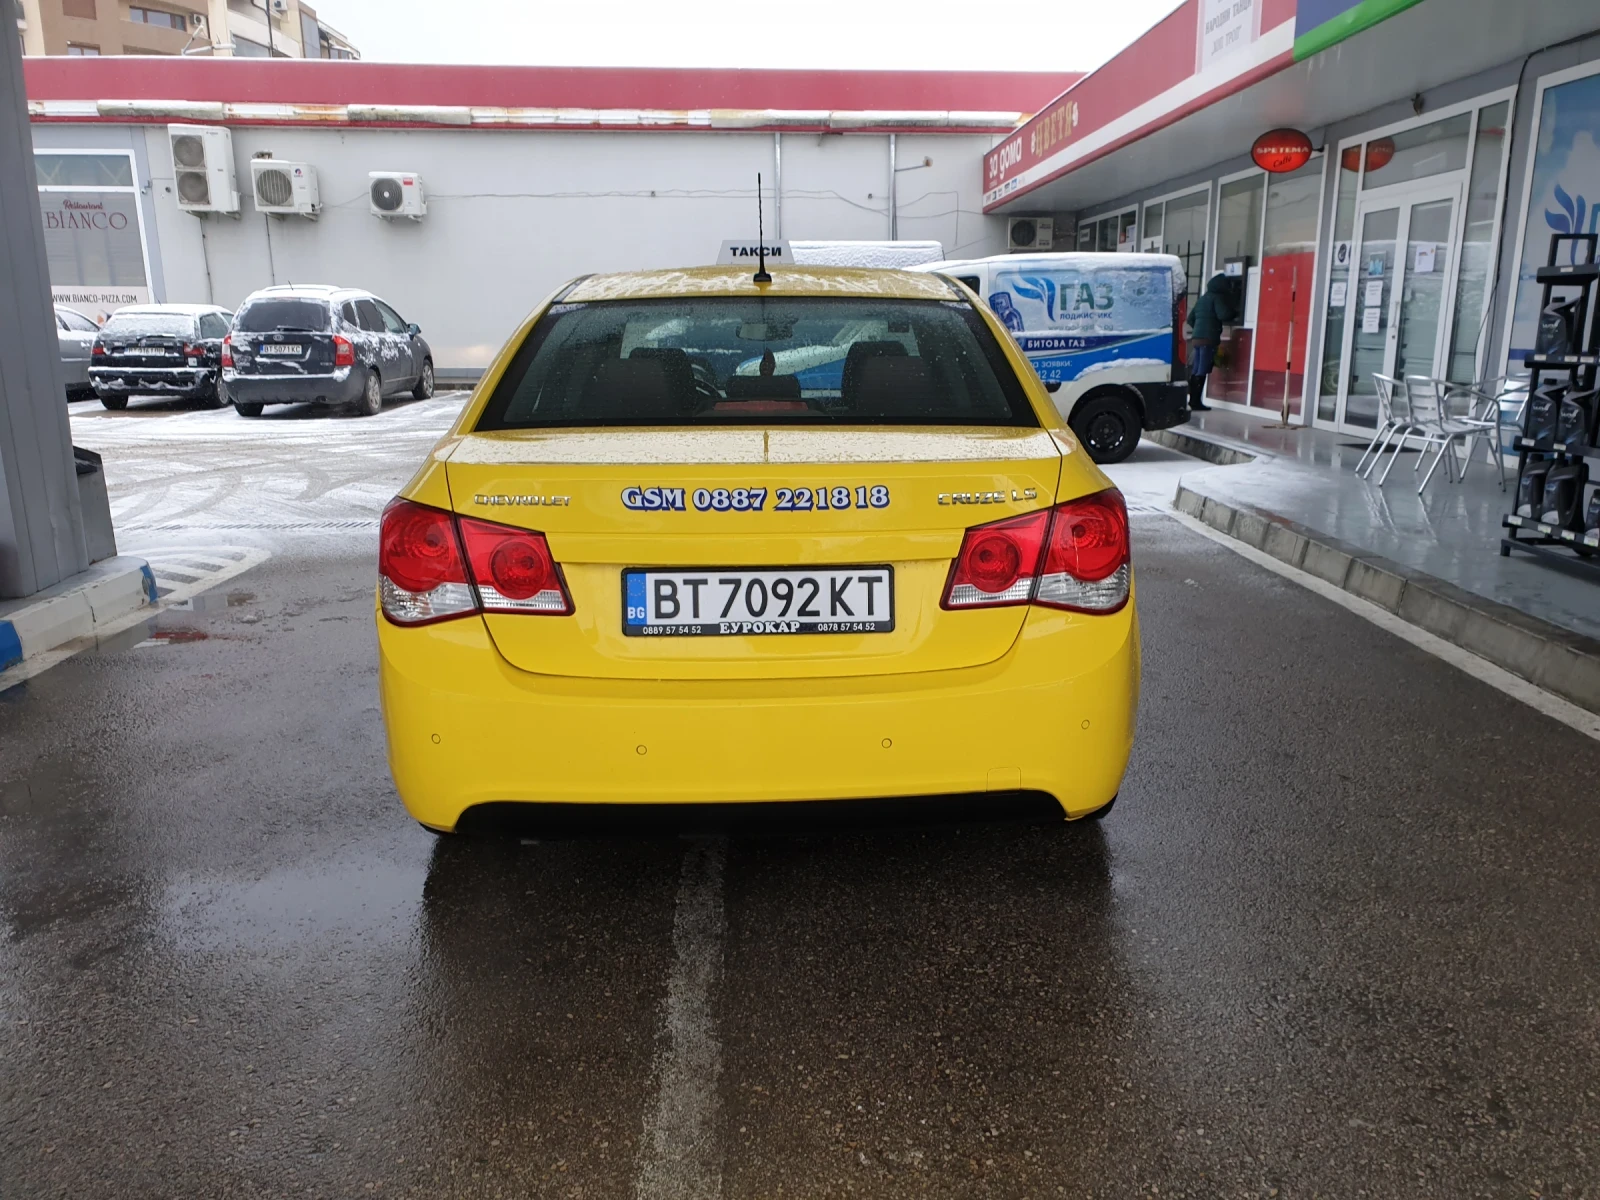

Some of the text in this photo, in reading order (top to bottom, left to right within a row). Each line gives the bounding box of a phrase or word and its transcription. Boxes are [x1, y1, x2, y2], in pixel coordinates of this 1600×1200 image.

[1036, 100, 1073, 158] ЦВЕТЯ
[63, 199, 103, 210] Restaurant
[45, 211, 128, 230] BIANCO
[730, 247, 782, 257] ТАКСИ
[1060, 283, 1114, 311] ГАЗ
[1060, 312, 1113, 320] ЛОДЖИСИКС
[1027, 338, 1085, 349] БИТОВА ГАЗ
[474, 493, 571, 507] CHEVROLET
[620, 485, 687, 512] GSM
[692, 486, 768, 512] 0887
[938, 487, 1037, 505] CRUZE LS
[627, 606, 645, 619] BG
[642, 625, 702, 635] 0889 57 54 52
[719, 620, 801, 634] ЕУРОКАР
[817, 622, 875, 632] 0878 57 54 52
